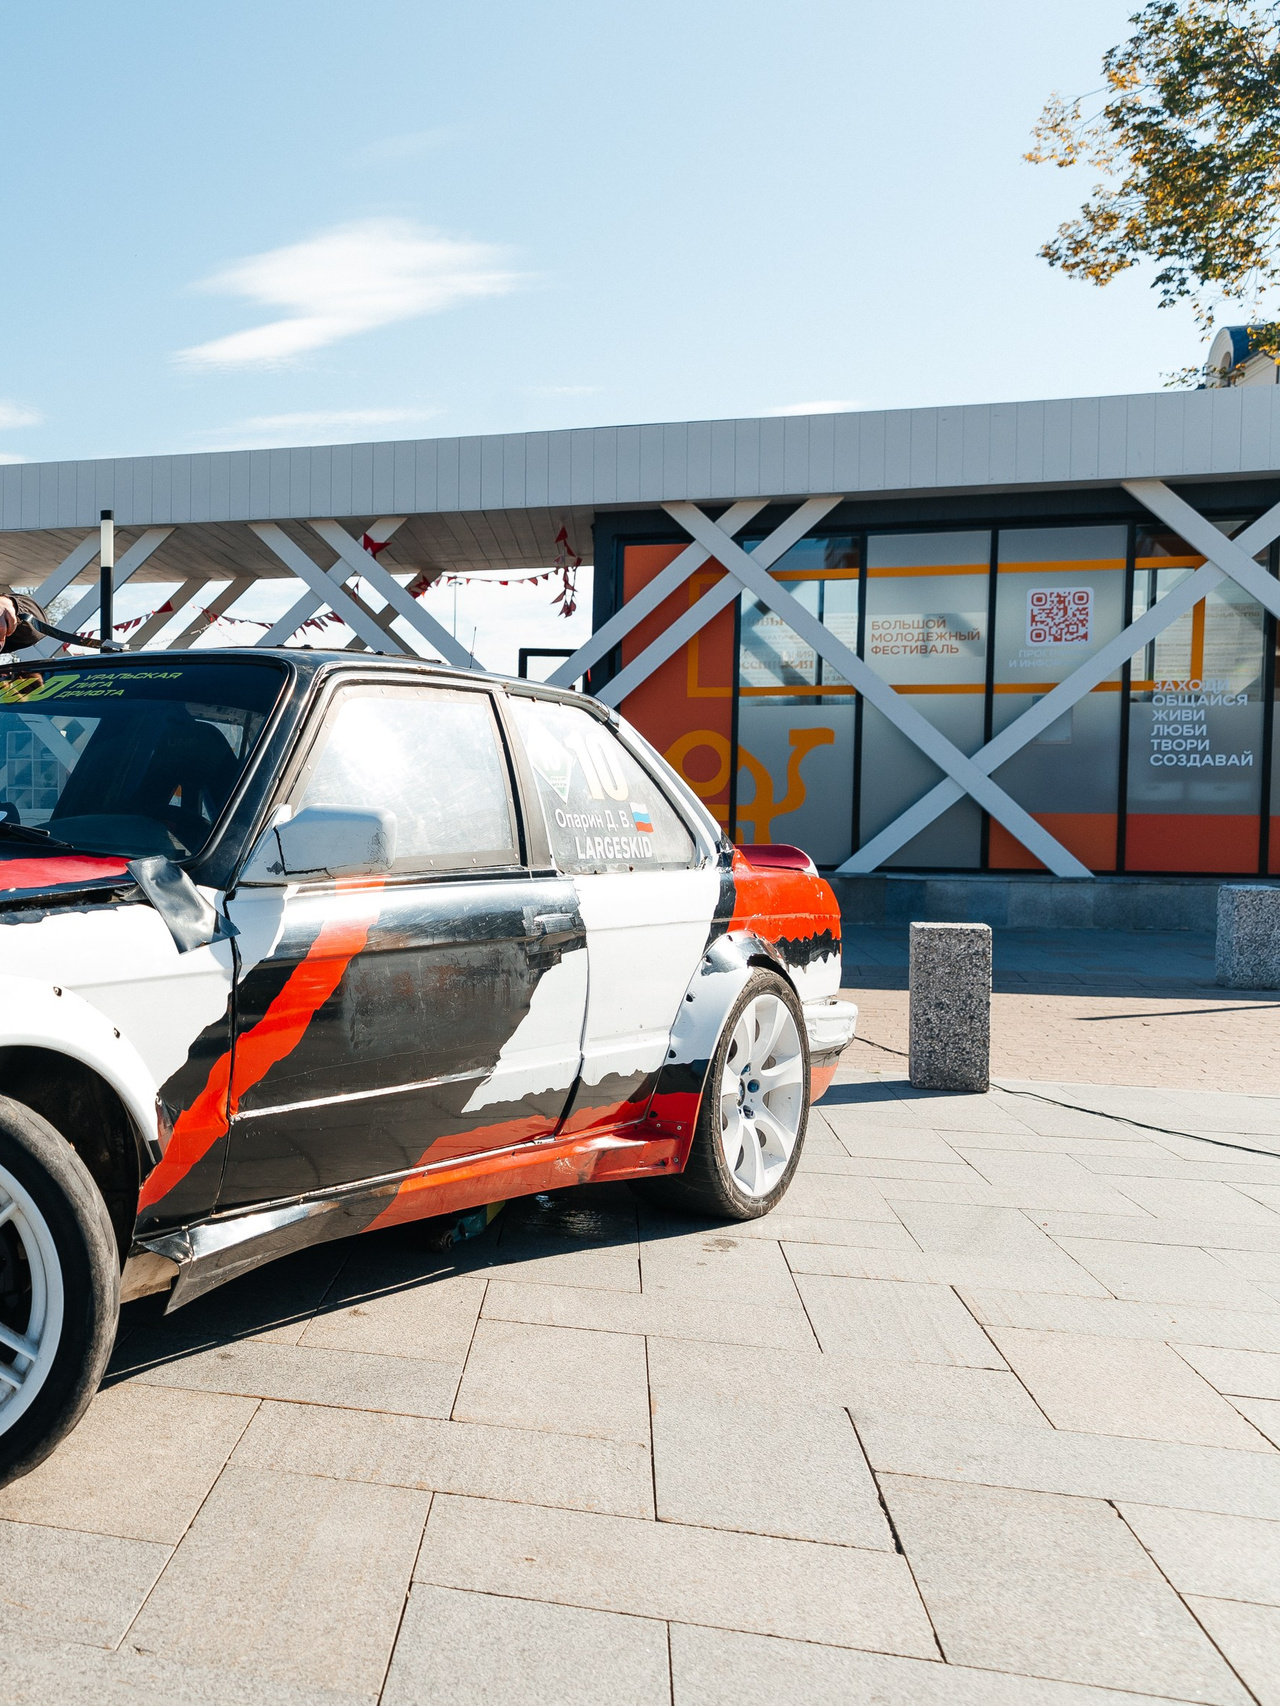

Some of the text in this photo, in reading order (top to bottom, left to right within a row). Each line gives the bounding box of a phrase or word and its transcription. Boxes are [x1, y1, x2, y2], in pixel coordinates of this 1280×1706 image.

[871, 616, 946, 630] БОЛЬШОЙ
[871, 628, 981, 643] МОЛОДЕЖНЫЙ
[870, 644, 960, 655] ФЕСТИВАЛЬ
[84, 672, 183, 681] УРАЛЬСКАЯ
[69, 681, 114, 689] ЛИГА
[1153, 679, 1231, 693] ЗАХОДИ
[53, 689, 125, 699] ДРИФТА
[1152, 690, 1249, 707] ОБЩАЙСЯ
[1151, 709, 1206, 722] ЖИВИ
[1150, 724, 1208, 736] ЛЮБИ
[1150, 739, 1210, 751] ТВОРИ
[1149, 750, 1254, 768] СОЗДАВАЙ
[554, 808, 605, 833] Опарин
[575, 836, 653, 860] LARGESKID
